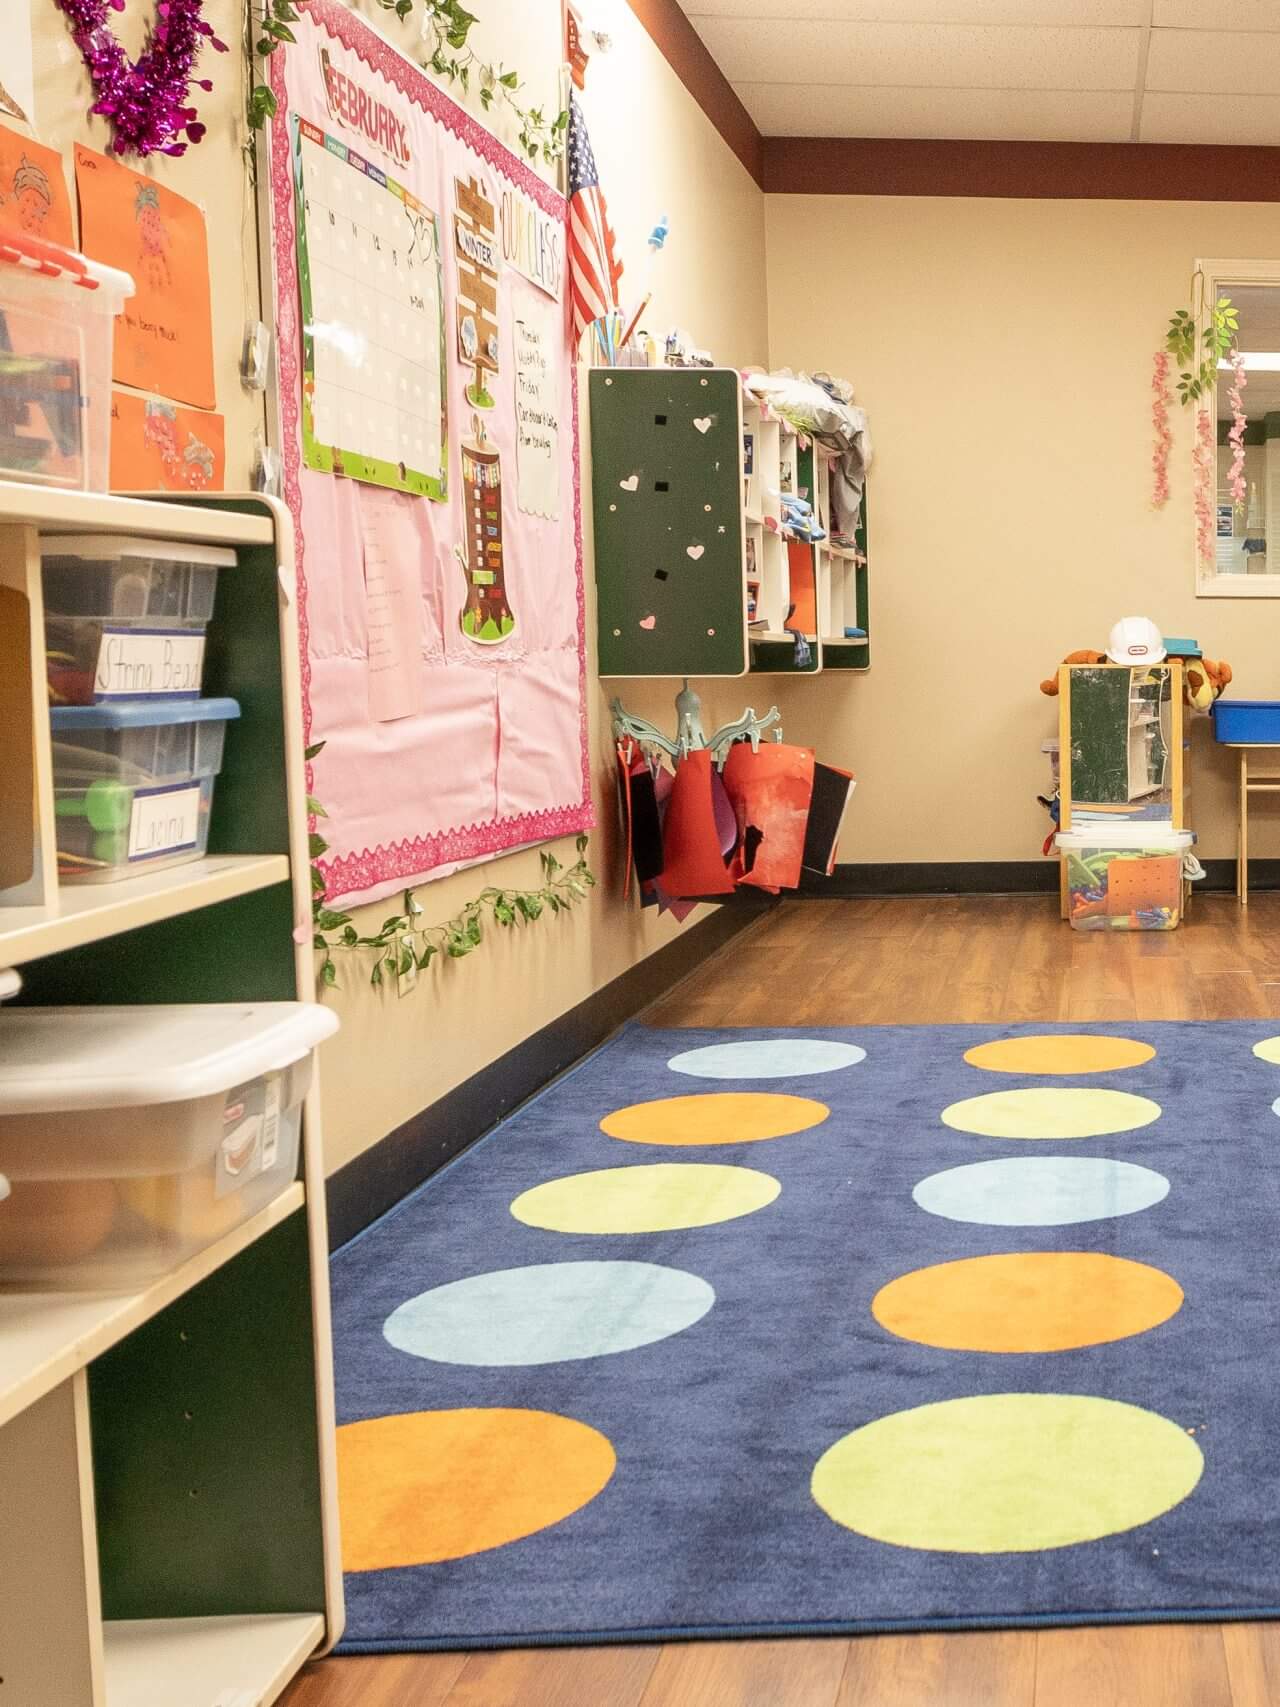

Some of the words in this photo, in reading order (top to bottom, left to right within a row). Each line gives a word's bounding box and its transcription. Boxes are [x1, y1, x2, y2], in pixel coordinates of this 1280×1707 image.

[326, 62, 407, 161] FEBRUARY
[463, 236, 494, 267] WINTER
[518, 372, 539, 402] Friday
